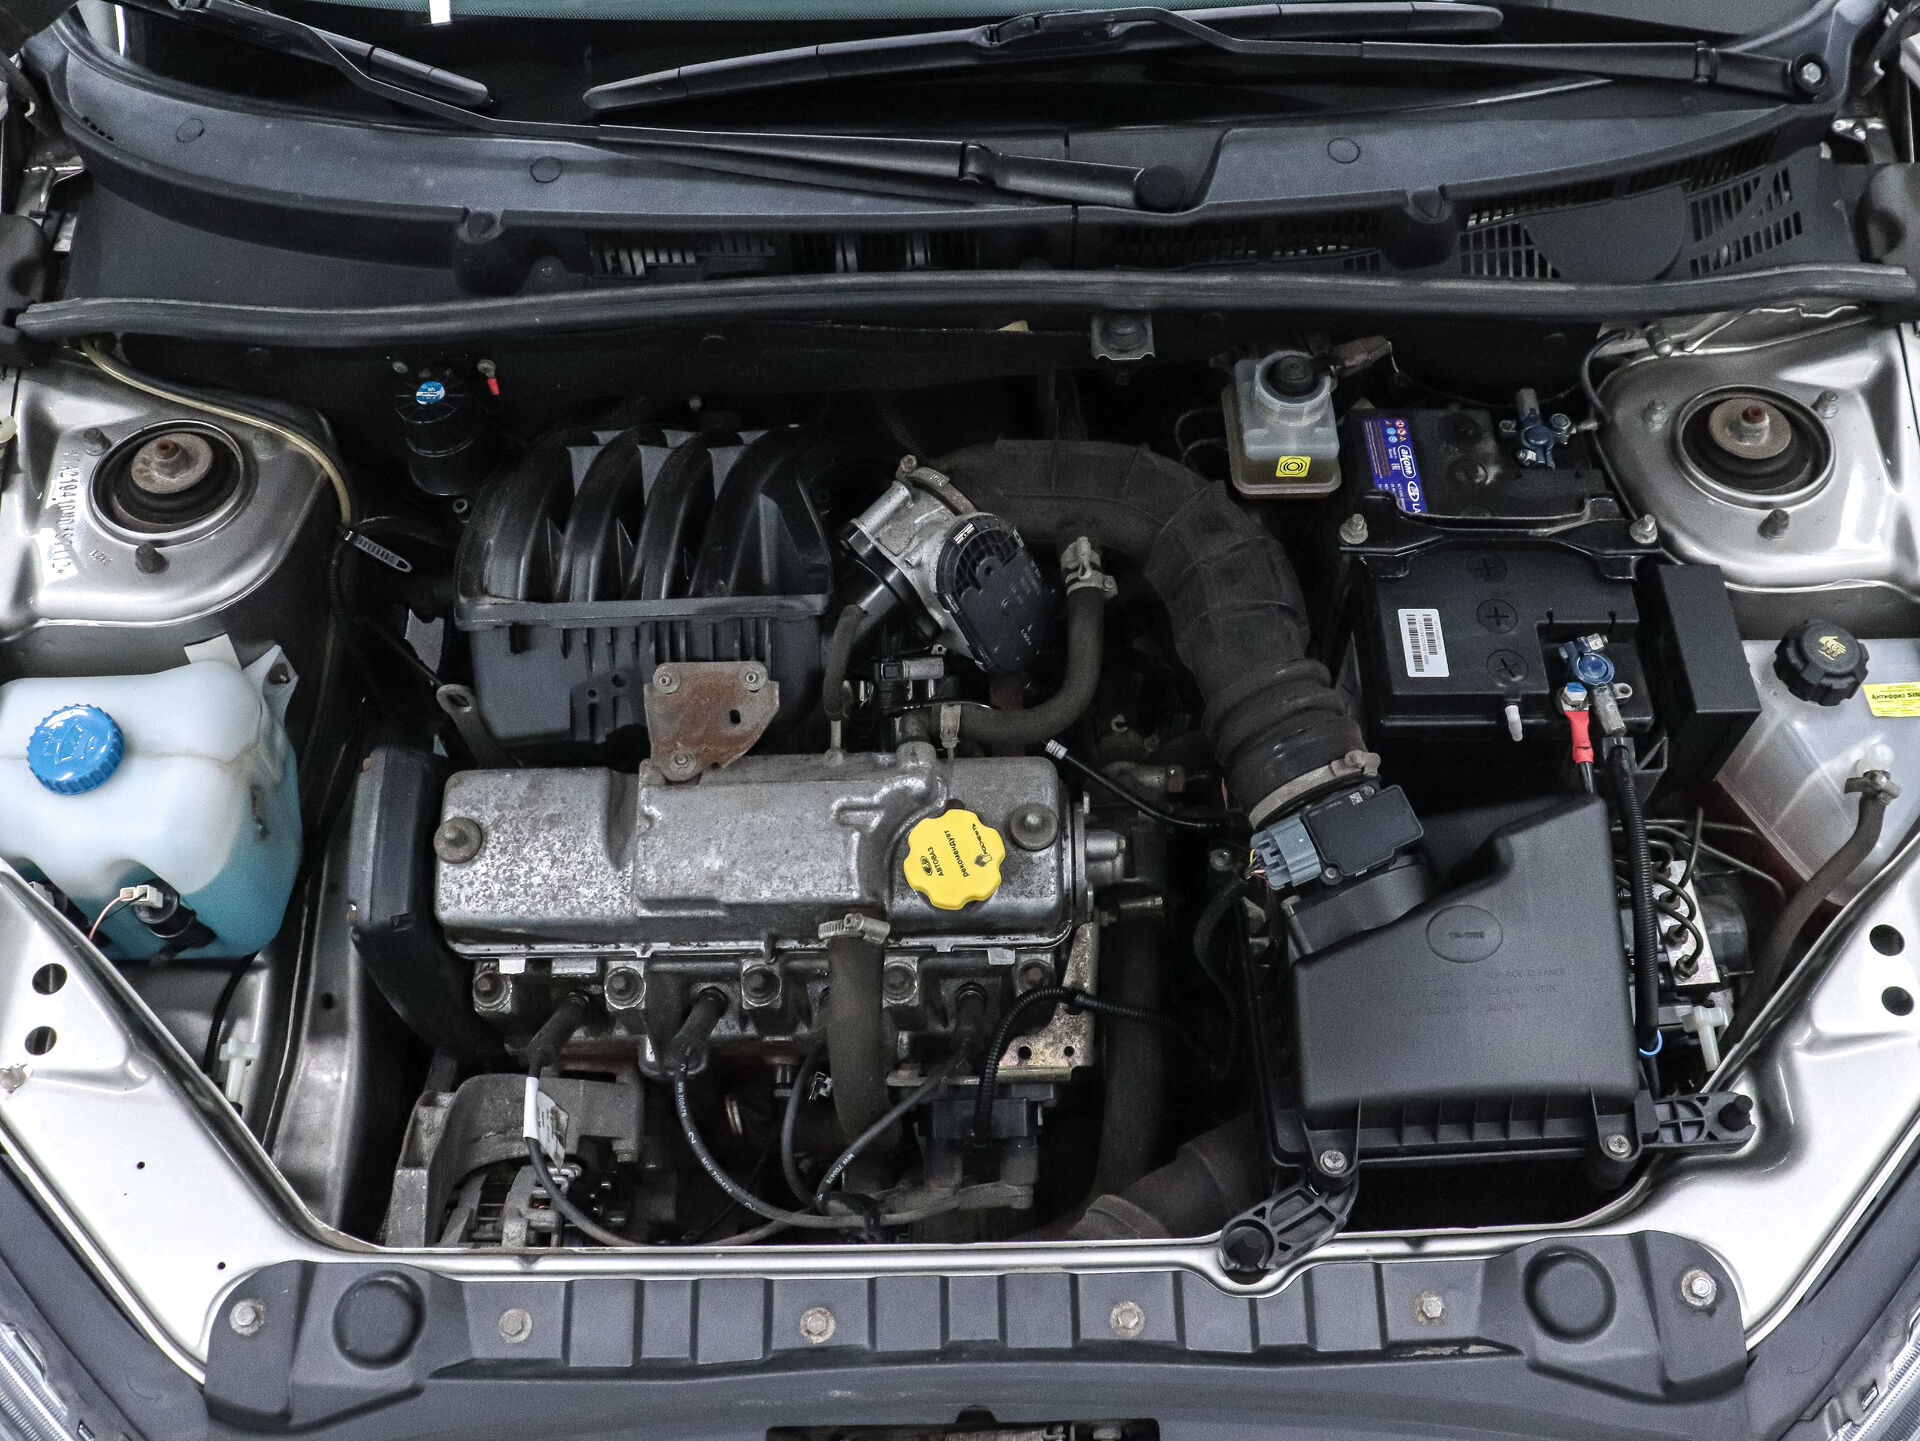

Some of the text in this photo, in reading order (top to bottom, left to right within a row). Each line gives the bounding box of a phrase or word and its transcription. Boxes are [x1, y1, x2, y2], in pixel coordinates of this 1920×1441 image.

[944, 830, 969, 877] рекомендует
[928, 847, 944, 876] АВТОВАЗ
[680, 1063, 687, 1072] 2
[688, 1131, 697, 1144] 2
[701, 1157, 713, 1171] MW
